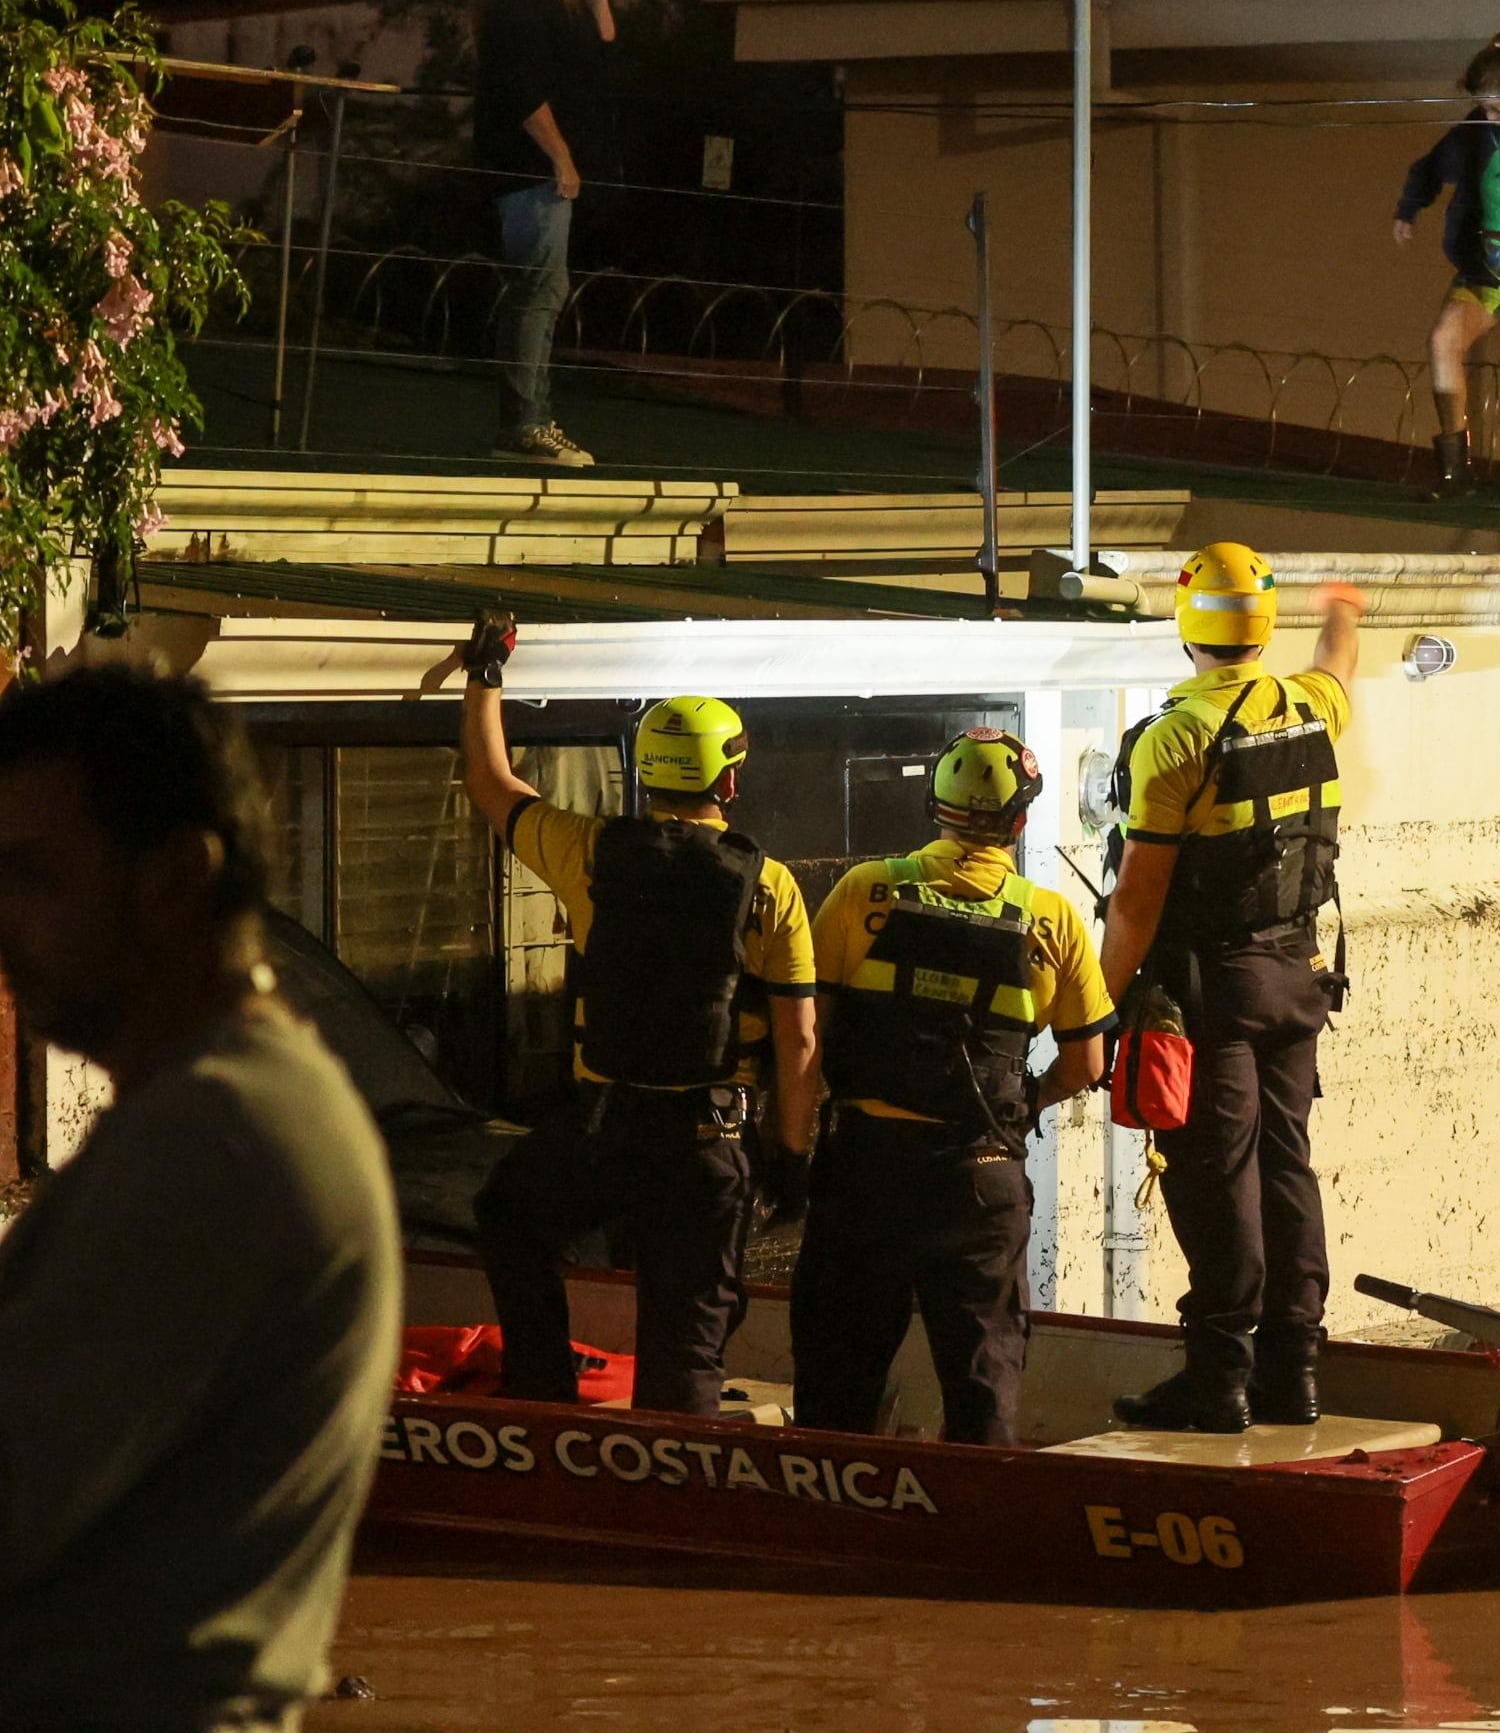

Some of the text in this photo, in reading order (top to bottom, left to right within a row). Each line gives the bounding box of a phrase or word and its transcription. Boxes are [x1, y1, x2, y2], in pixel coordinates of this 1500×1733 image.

[555, 1430, 770, 1490] COSTA
[778, 1453, 939, 1514] RICA
[1084, 1504, 1245, 1569] E-06
